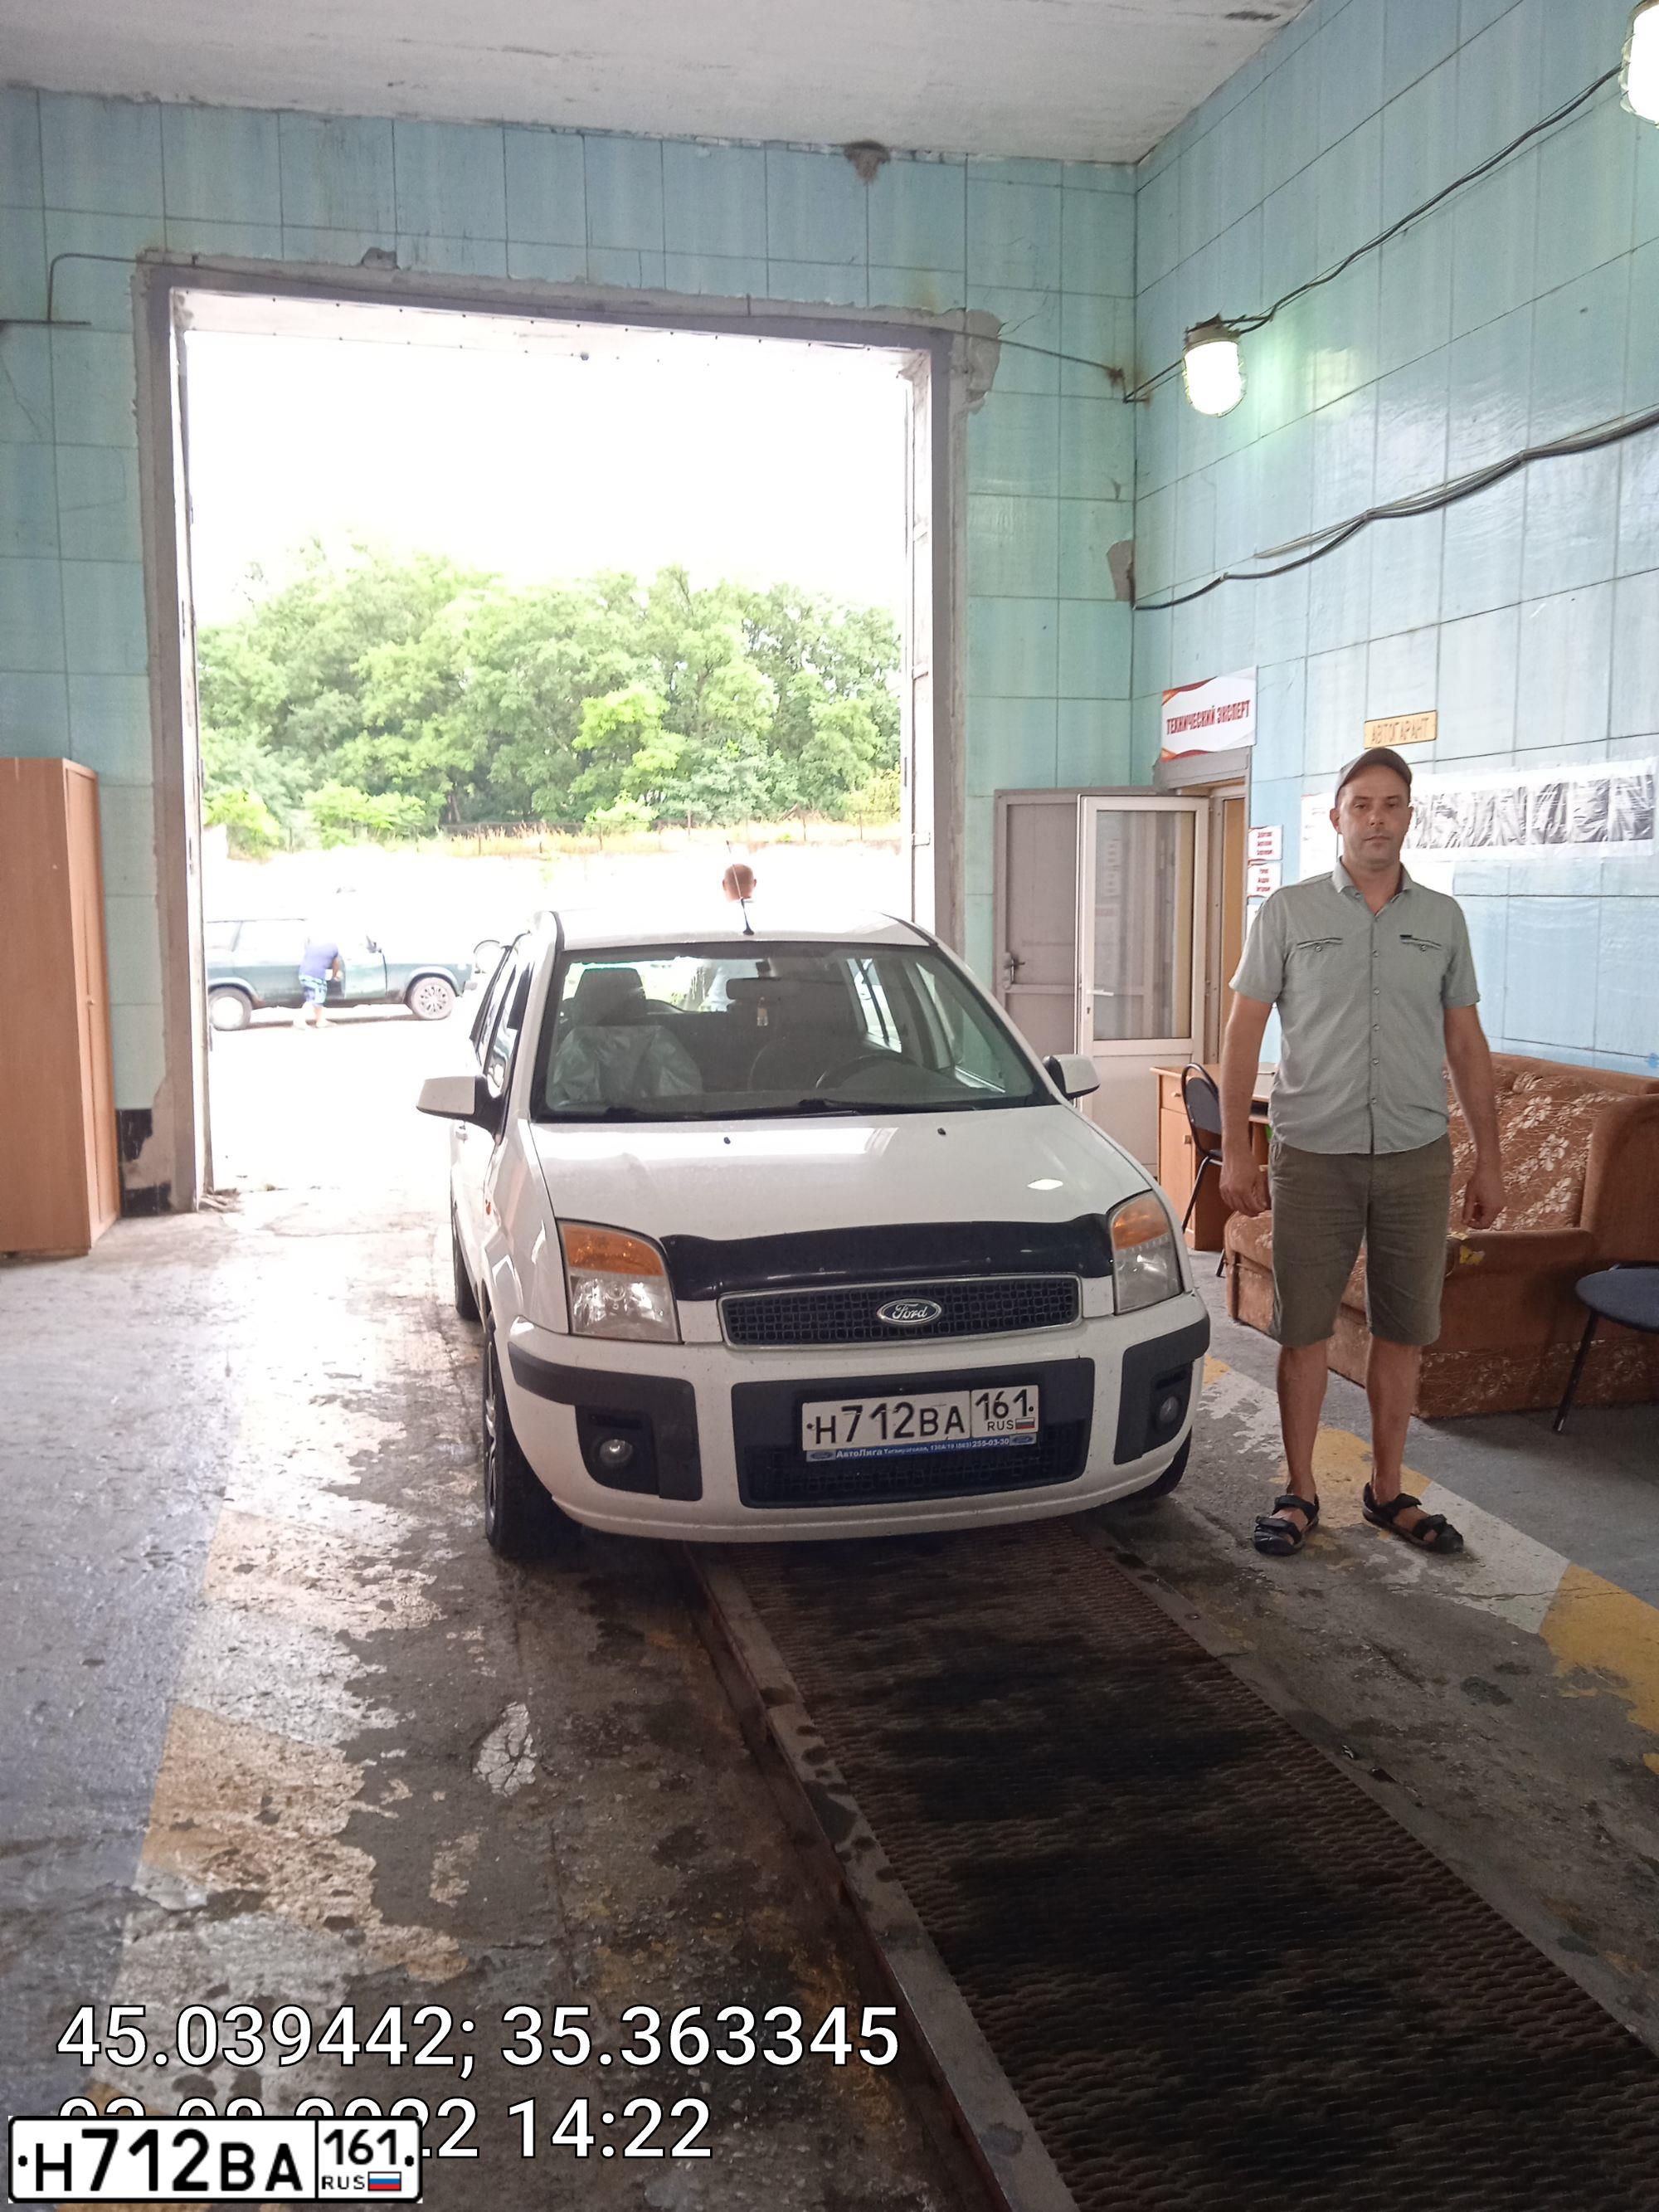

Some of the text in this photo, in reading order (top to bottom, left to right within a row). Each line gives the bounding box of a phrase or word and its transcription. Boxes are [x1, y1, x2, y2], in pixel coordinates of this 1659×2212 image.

[1166, 700, 1250, 735] ТЕХНИЧЕСКИЙ ЭКСПЕРТ
[892, 1303, 928, 1319] Ford
[815, 1389, 1029, 1445] Н712ВА 161
[987, 1420, 1014, 1432] RUS
[836, 1449, 883, 1459] АвтоЛига
